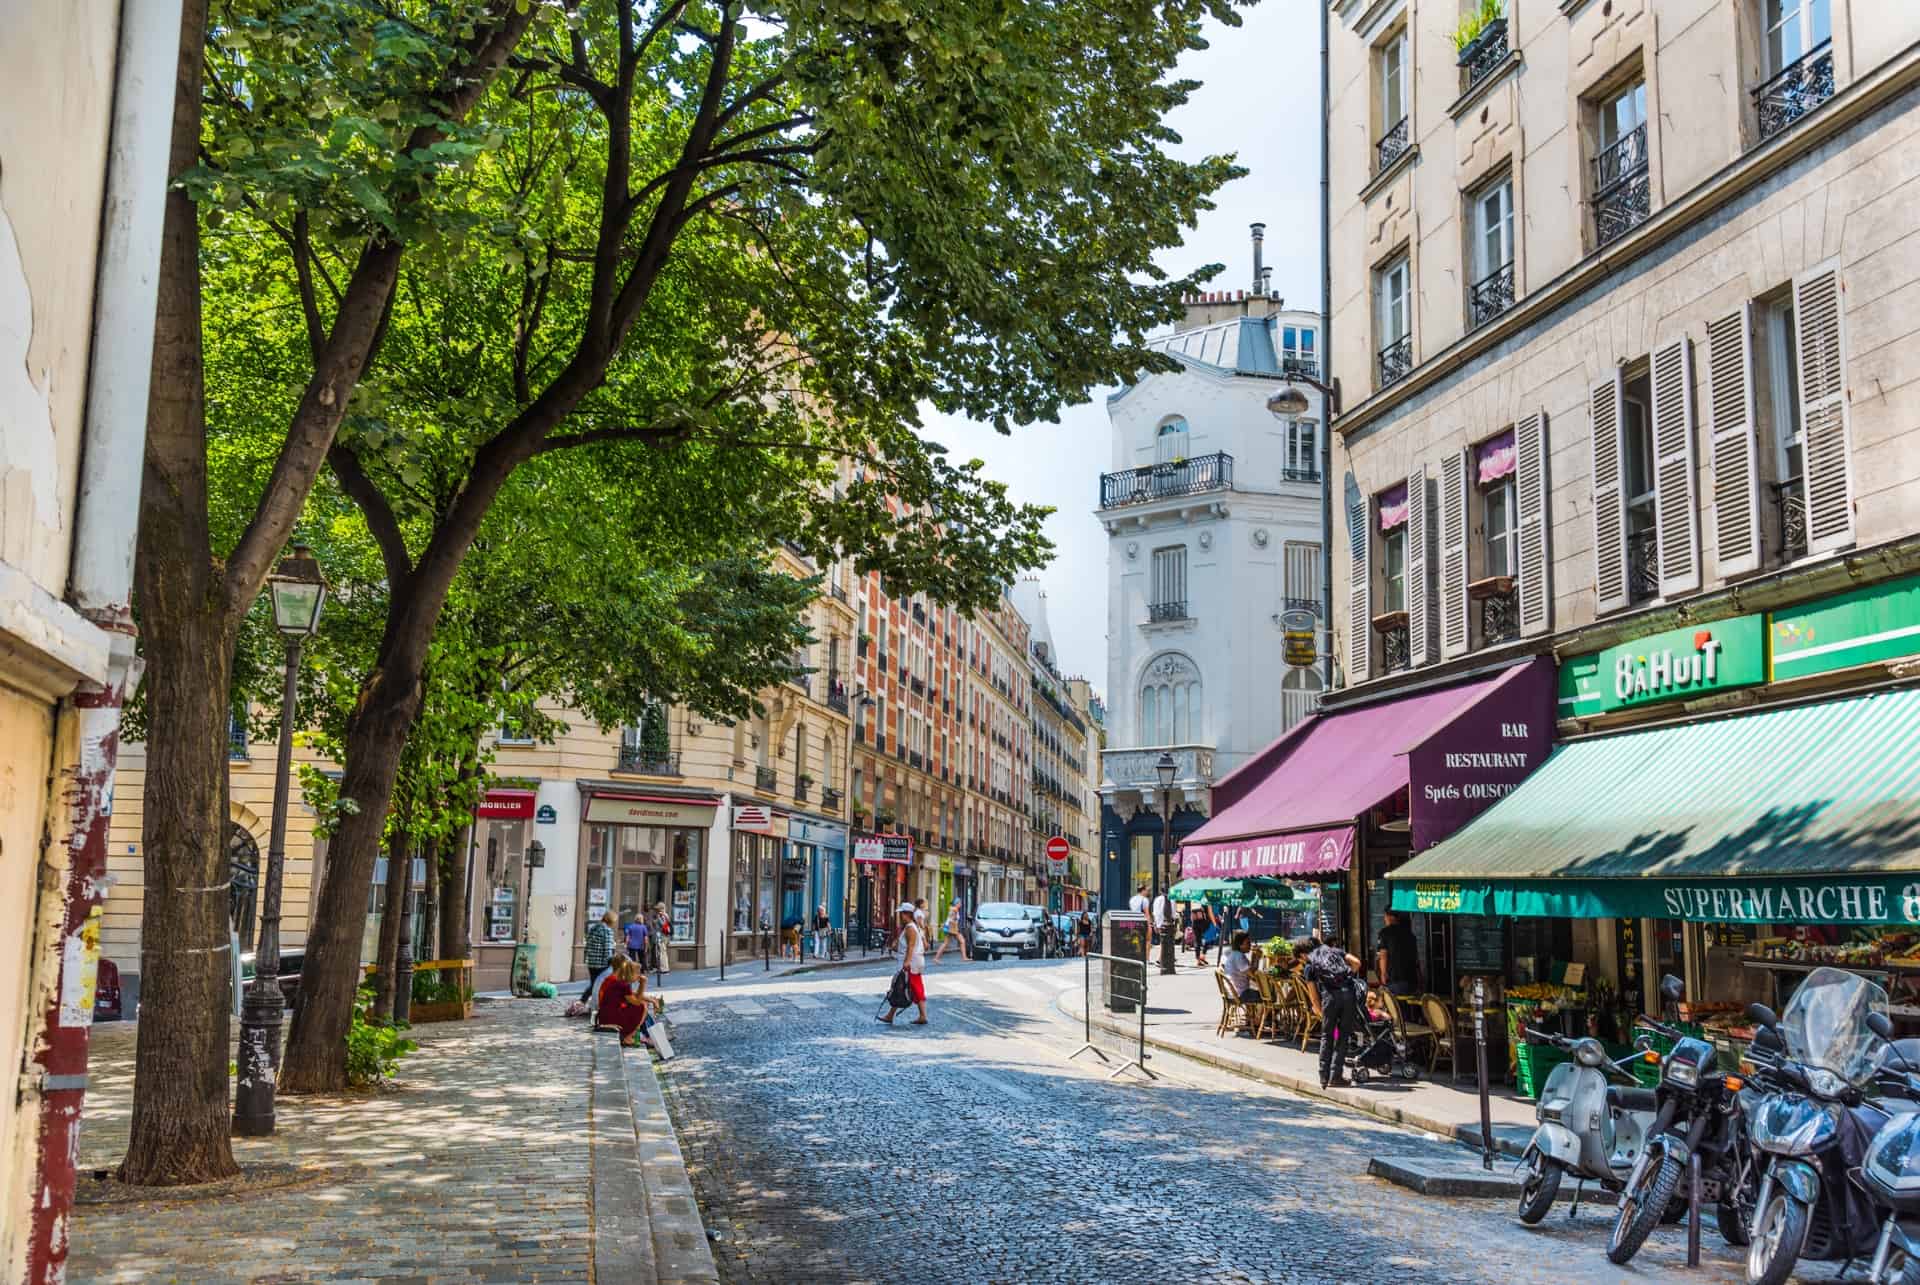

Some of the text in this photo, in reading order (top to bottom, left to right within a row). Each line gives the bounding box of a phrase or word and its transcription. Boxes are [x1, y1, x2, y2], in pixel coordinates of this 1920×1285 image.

[1502, 723, 1528, 738] BAR
[1446, 753, 1527, 768] RESTAURANT
[1463, 783, 1518, 799] COUSCO
[1212, 849, 1237, 871] CAFE
[1256, 842, 1306, 866] THEATRE
[1416, 882, 1460, 896] OUVERT DE
[1664, 886, 1888, 920] SUPERMARCHE
